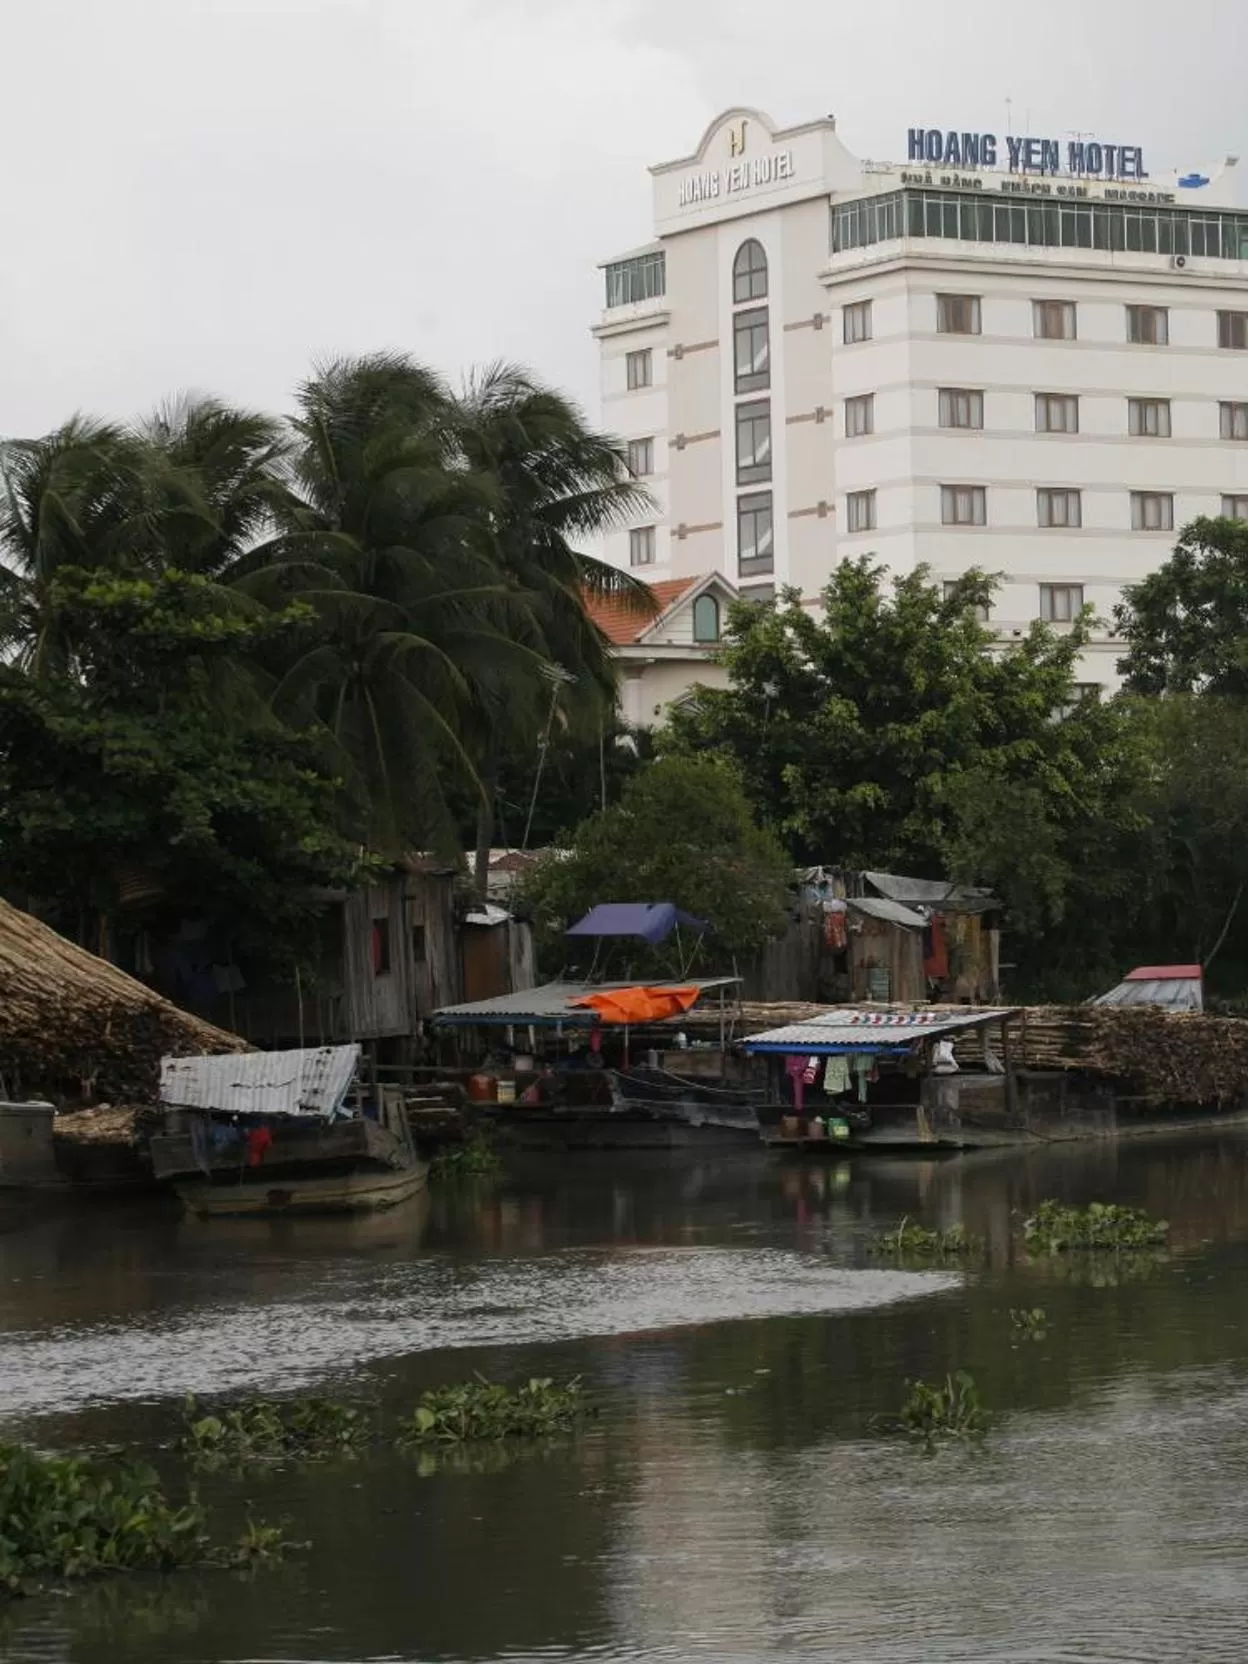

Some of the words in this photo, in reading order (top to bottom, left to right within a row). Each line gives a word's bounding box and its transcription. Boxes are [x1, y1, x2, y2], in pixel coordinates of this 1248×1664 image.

[679, 171, 721, 207] HOANG
[722, 162, 751, 194] YEN
[753, 149, 796, 186] HOTEL
[907, 128, 996, 166] HOANG
[1006, 136, 1060, 172] YEN
[1067, 141, 1149, 178] HOTEL
